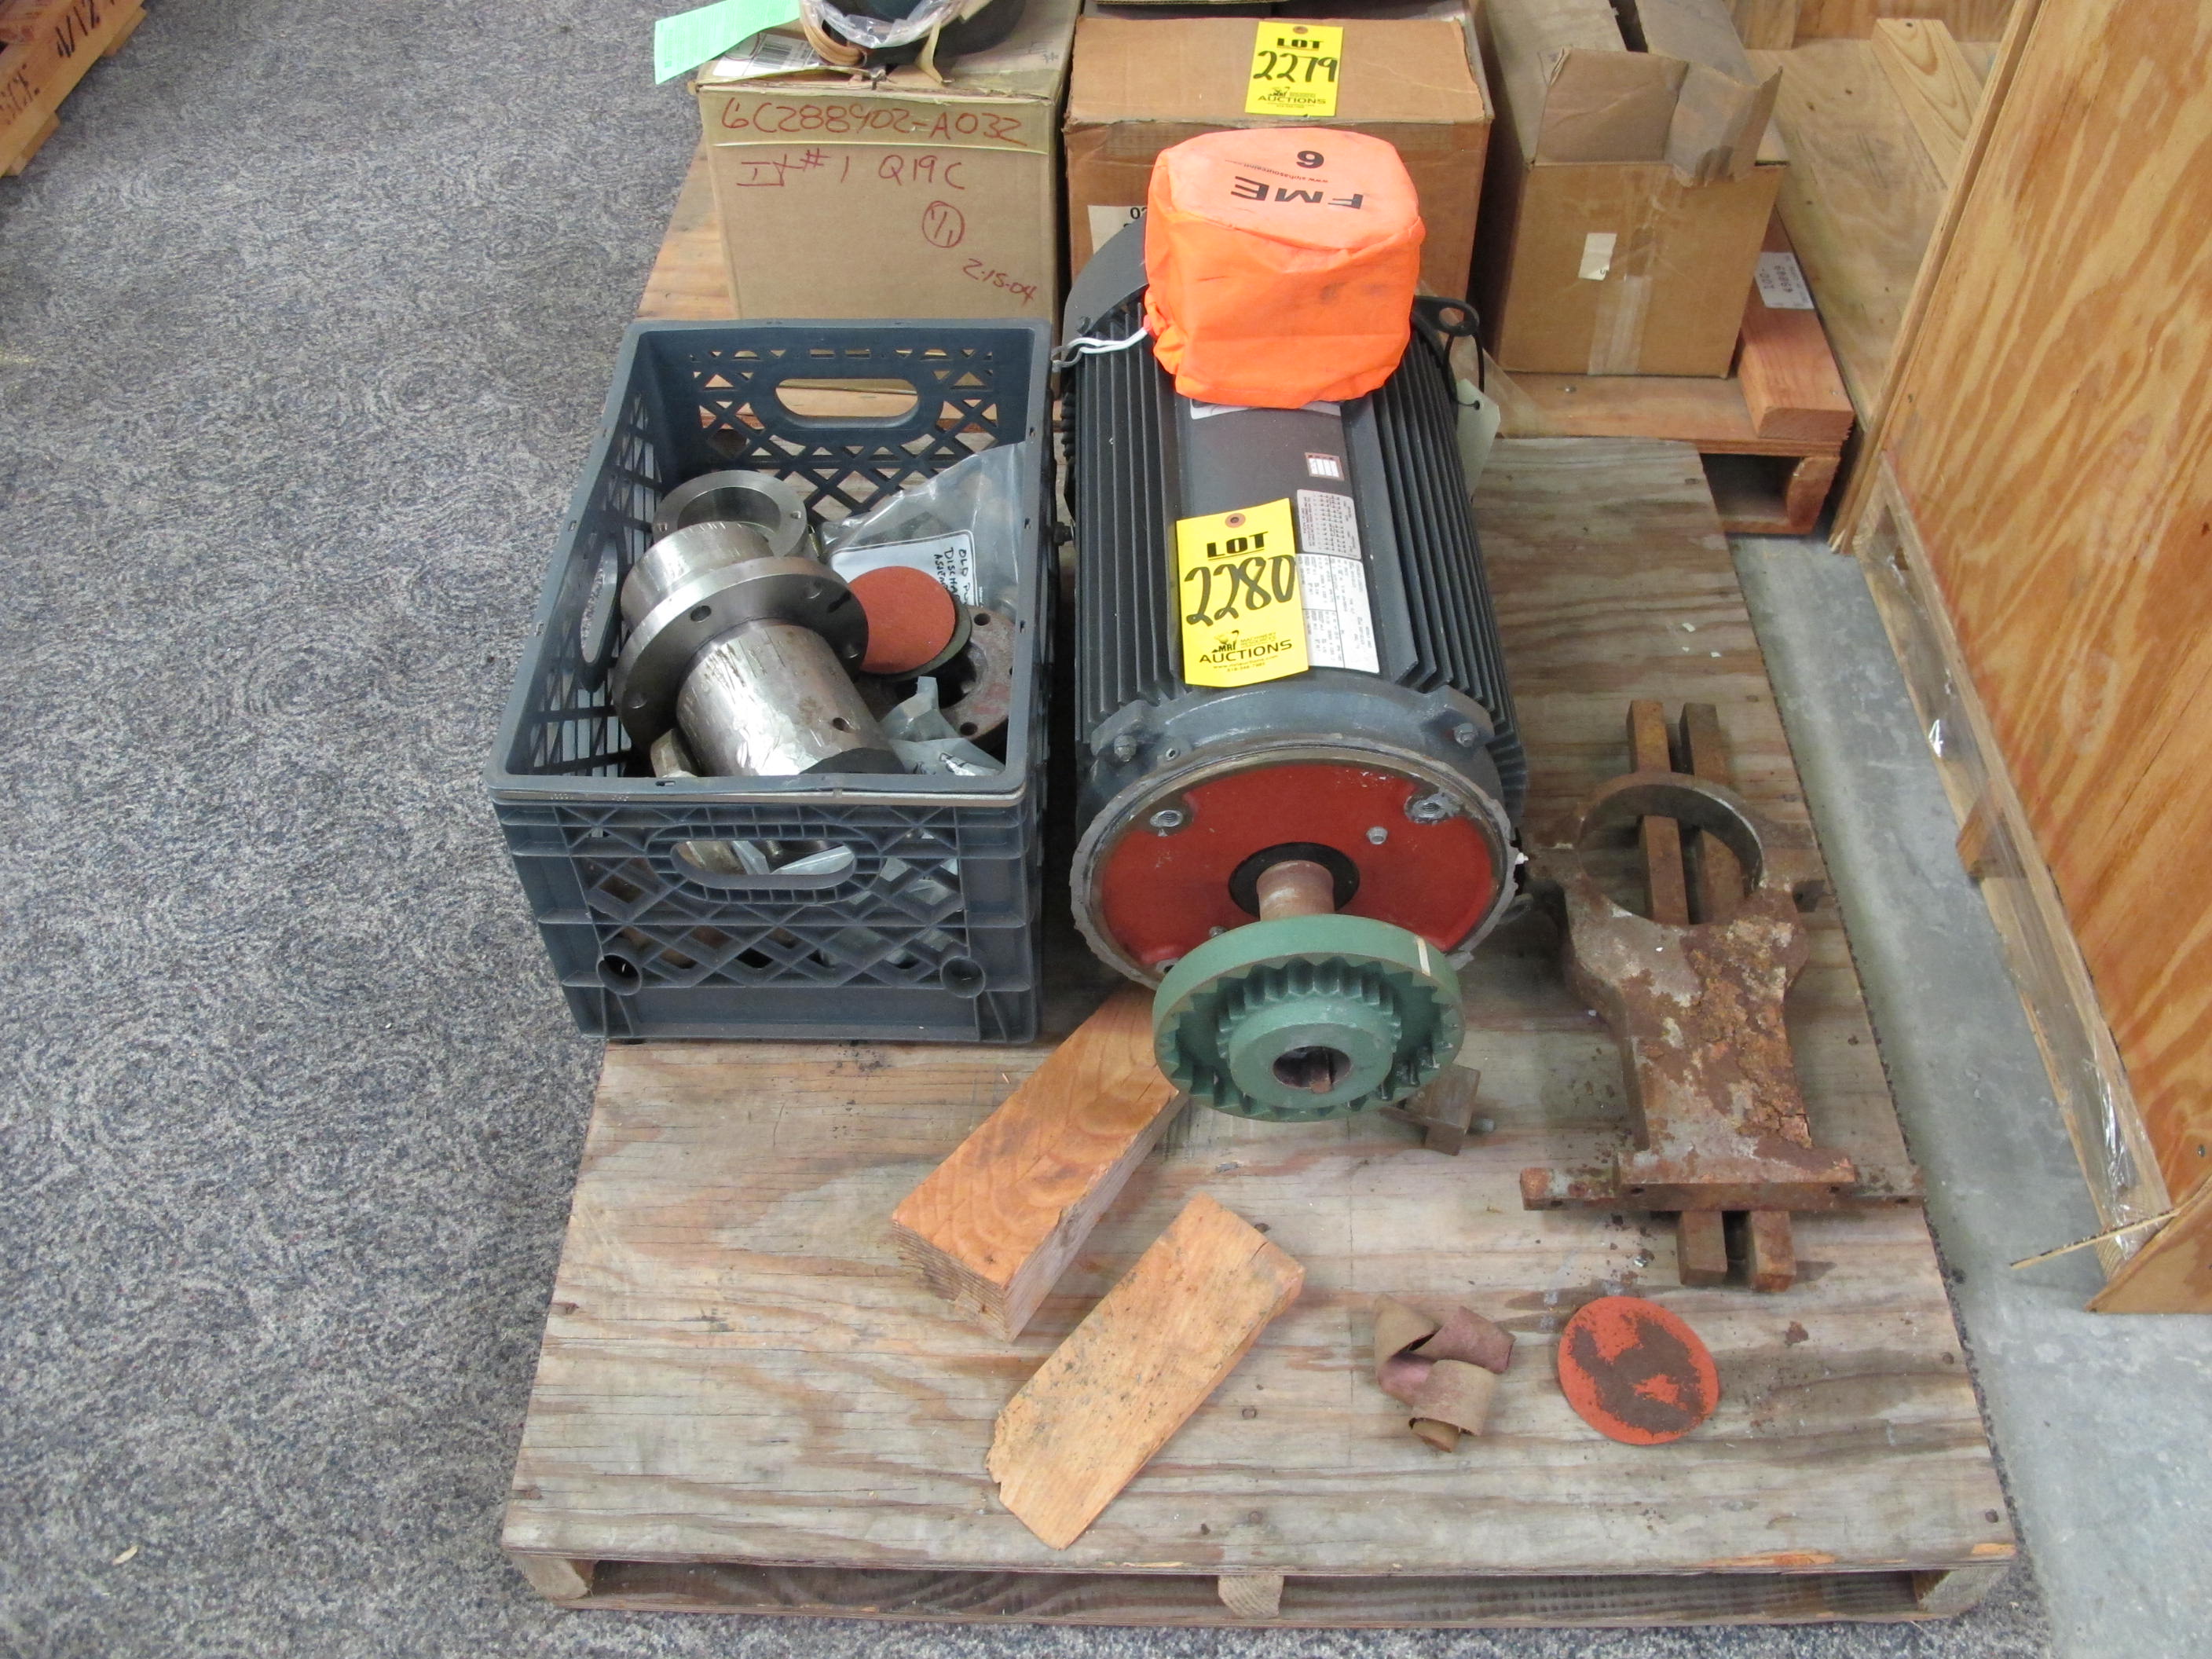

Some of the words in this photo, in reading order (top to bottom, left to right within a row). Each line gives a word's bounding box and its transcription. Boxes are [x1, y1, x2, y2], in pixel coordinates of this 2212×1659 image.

[1277, 38, 1324, 49] LOT
[1253, 50, 1338, 82] 2279
[1258, 95, 1327, 104] AUCTIONS
[1296, 150, 1324, 169] 6
[1231, 176, 1364, 209] FME
[1207, 532, 1269, 558] LOT
[1184, 555, 1296, 627] 2280
[1199, 639, 1293, 663] AUCTIONS
